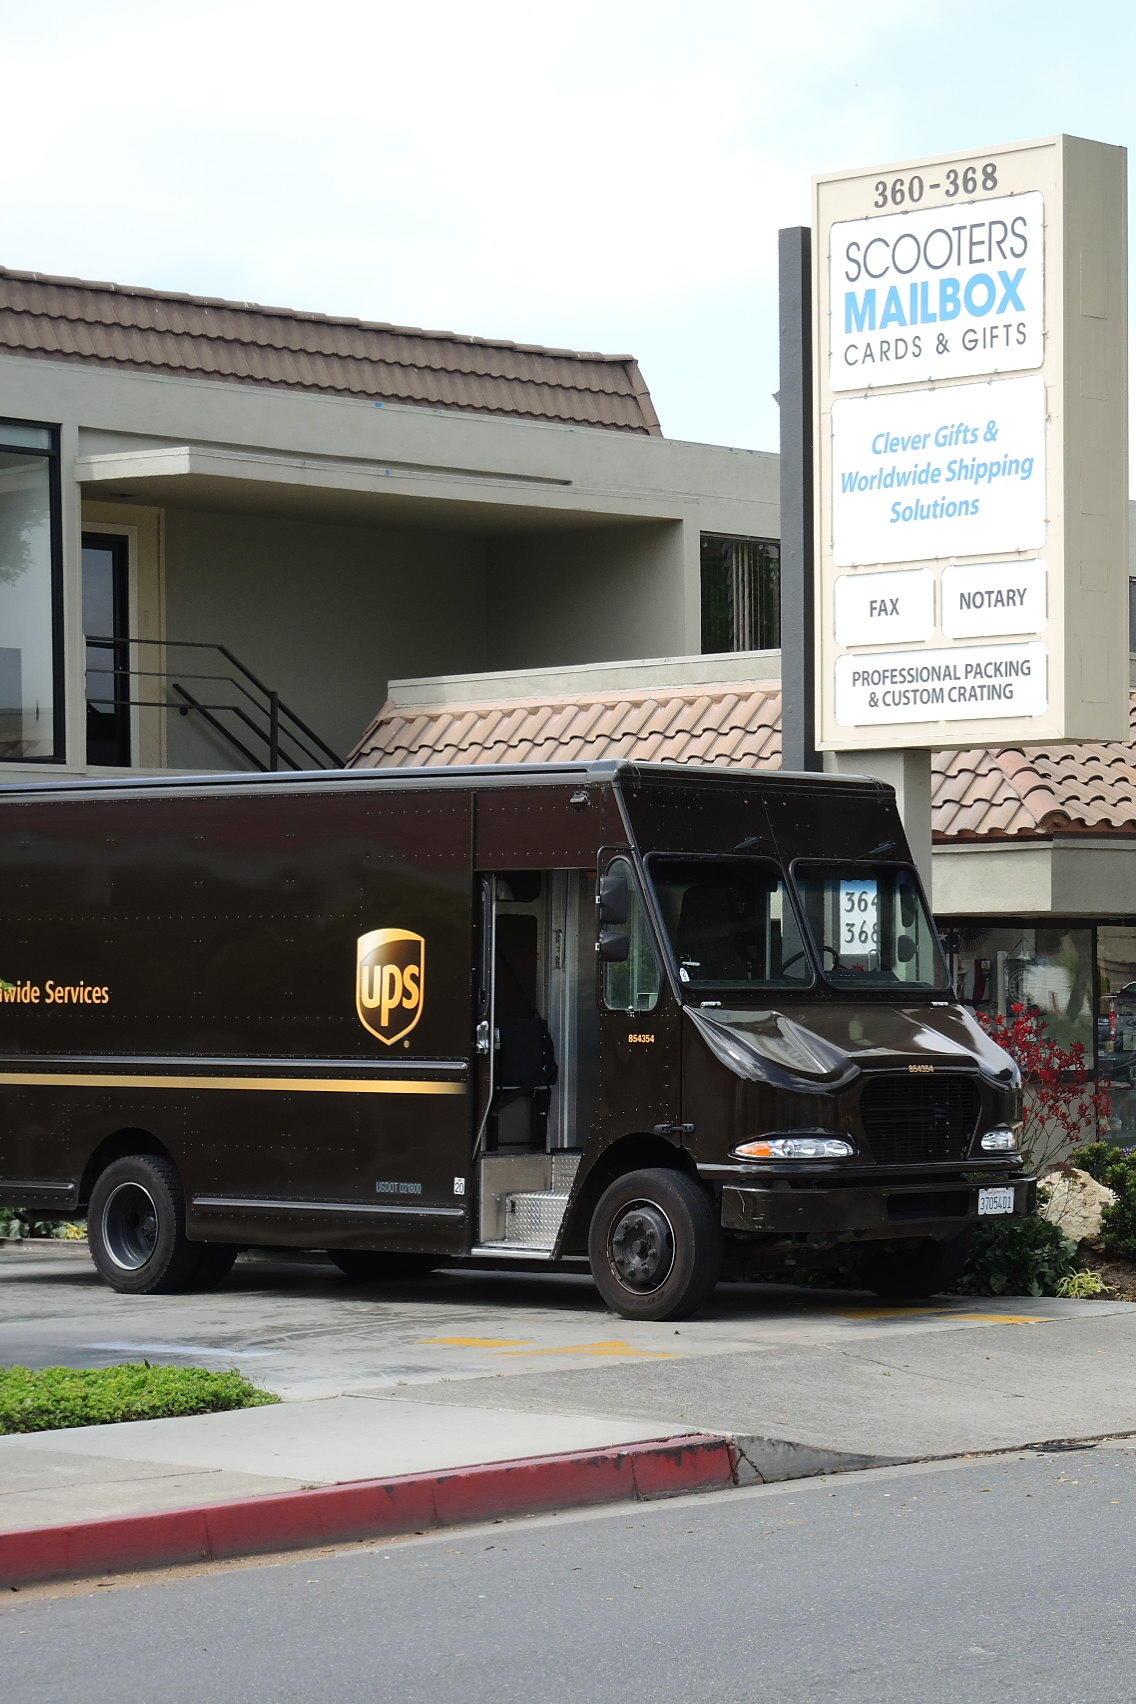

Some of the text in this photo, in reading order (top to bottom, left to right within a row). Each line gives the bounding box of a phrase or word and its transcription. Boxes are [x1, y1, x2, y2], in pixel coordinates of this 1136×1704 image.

[873, 162, 999, 209] 360-368
[844, 216, 1028, 283] SCOOTERS
[844, 267, 1027, 334] MAILBOX
[844, 322, 1027, 366] CARDS & GIFTS
[871, 419, 999, 455] Clever Gifts &
[840, 453, 1034, 493] Worldwide Shipping
[889, 495, 980, 523] Solutions
[869, 597, 900, 617] FAX
[959, 587, 1027, 610] NOTARY
[852, 659, 1031, 687] PROFESSIONAL PACKING
[868, 682, 1014, 708] & CUSTOM CRATING
[45, 980, 110, 1004] Services
[361, 964, 420, 1027] ups
[628, 1034, 655, 1043] 854354
[376, 1181, 399, 1193] USDOT
